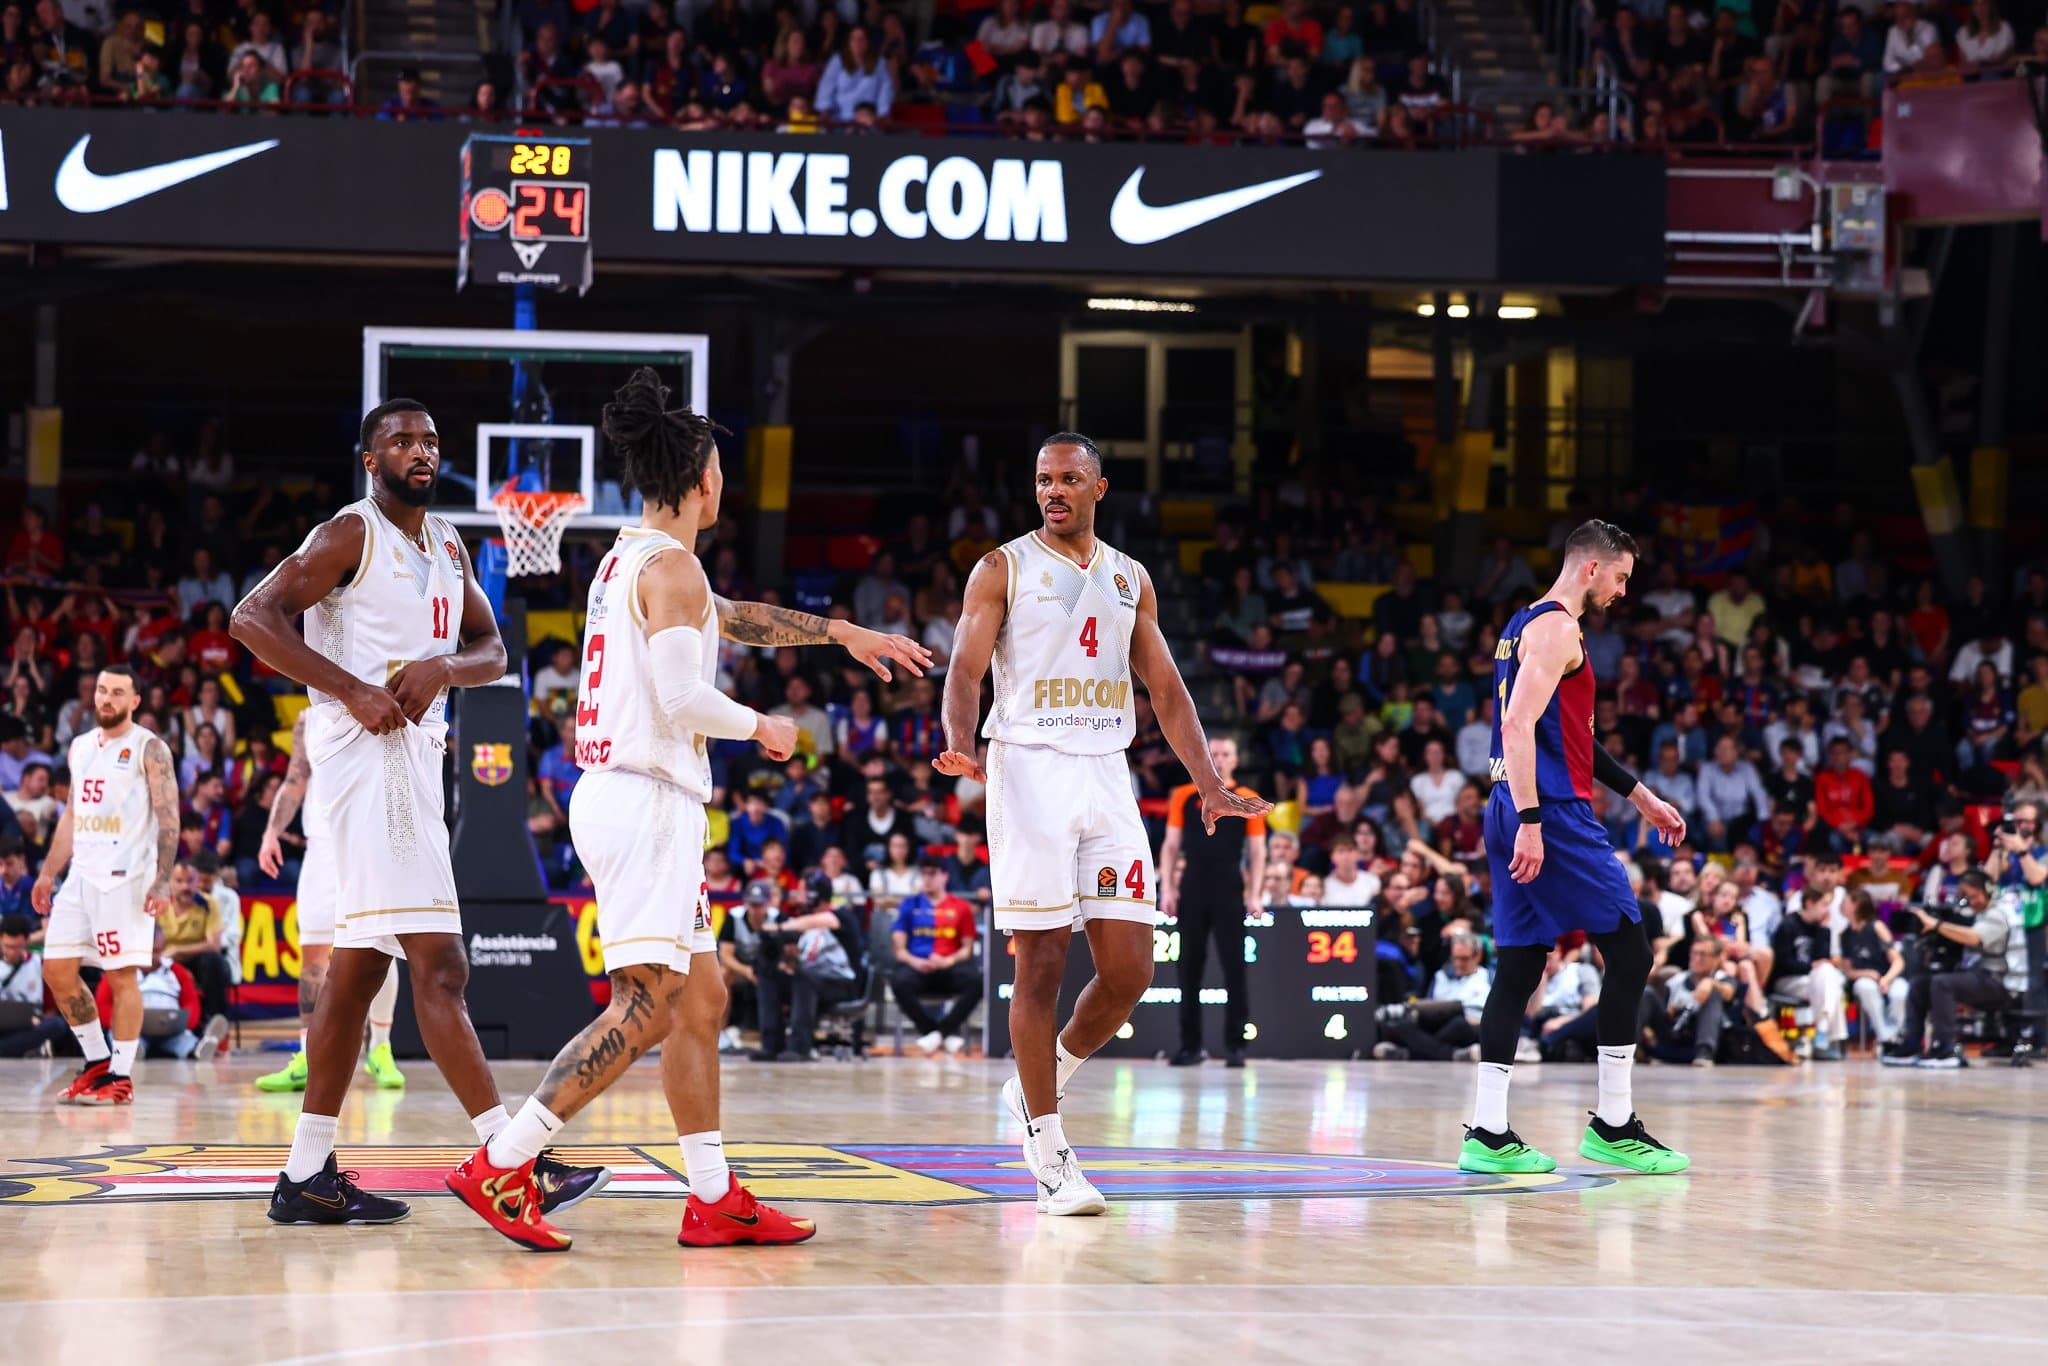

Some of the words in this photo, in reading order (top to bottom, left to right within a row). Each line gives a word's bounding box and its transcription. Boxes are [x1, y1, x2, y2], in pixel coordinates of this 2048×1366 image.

[514, 185, 584, 237] 24
[653, 148, 1068, 242] NIKE.COM
[432, 596, 449, 640] 11
[1079, 616, 1099, 658] 4
[1035, 678, 1129, 709] FEDCOM
[82, 779, 105, 804] 55
[1125, 859, 1146, 900] 4
[97, 931, 121, 956] 55
[1306, 930, 1359, 963] 34
[1324, 1014, 1348, 1040] 4
